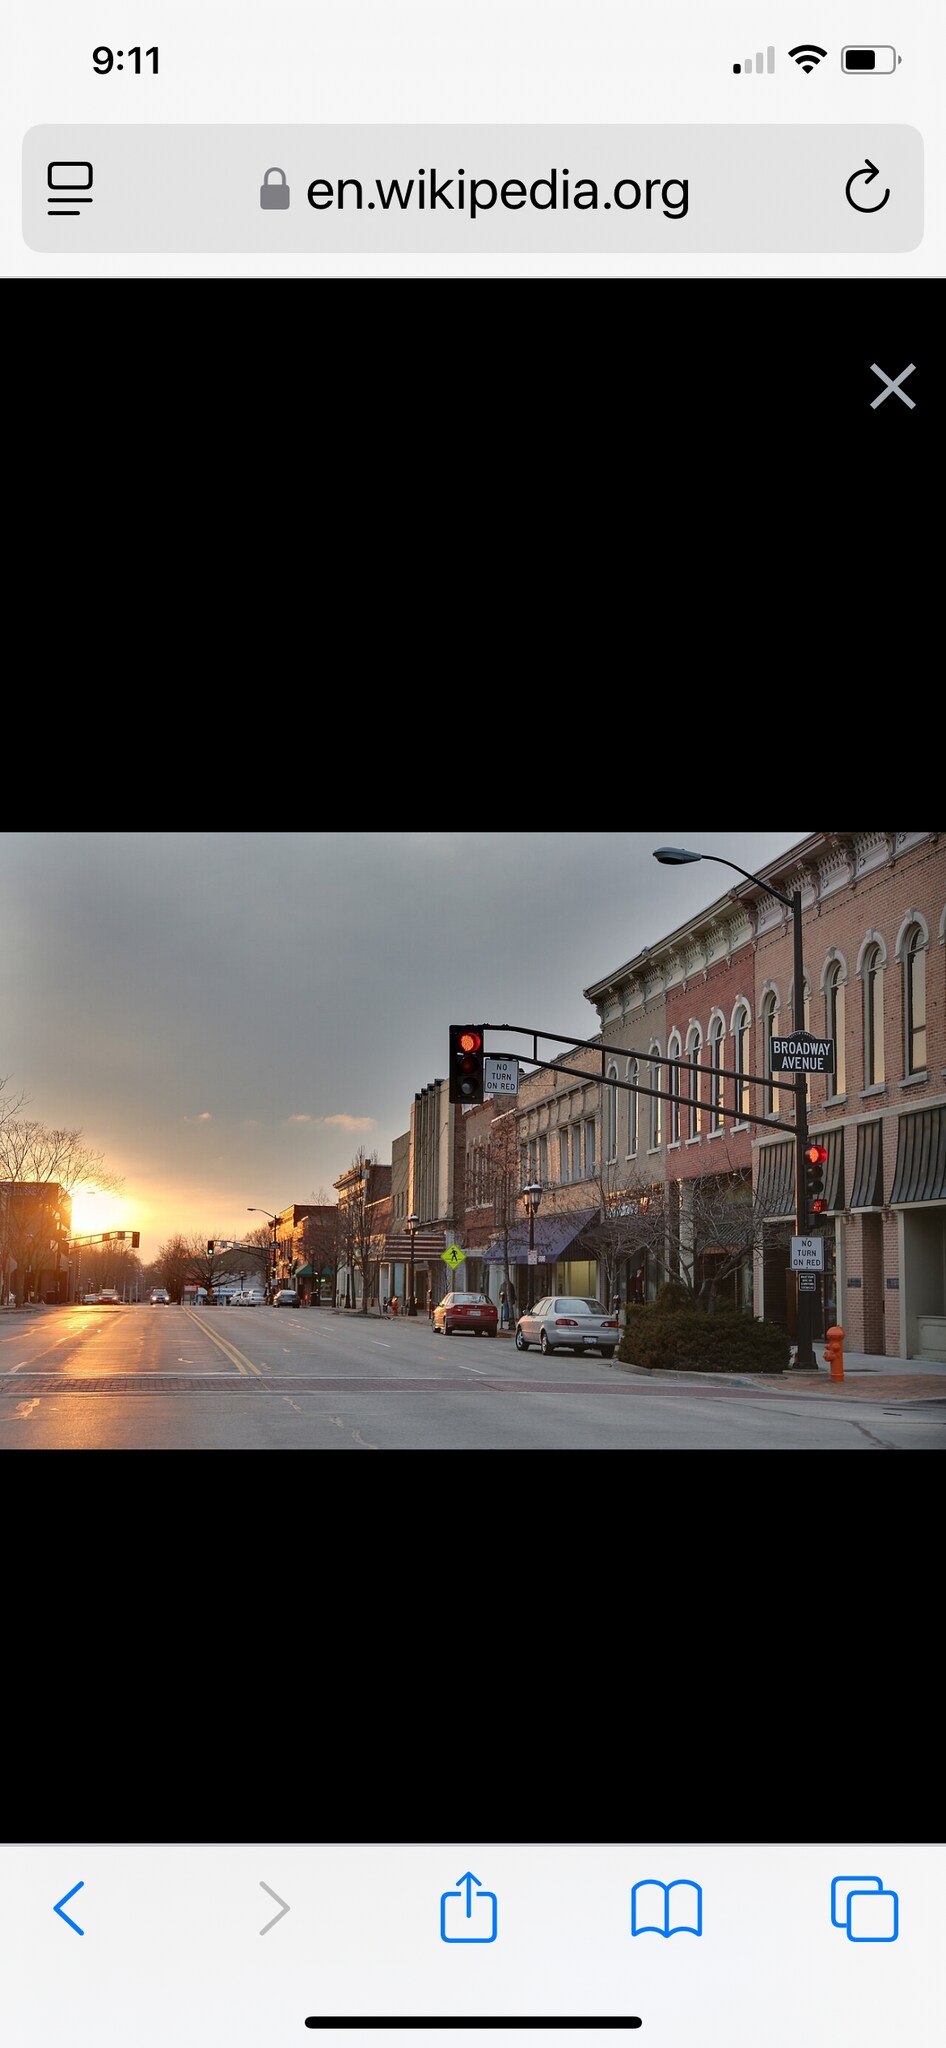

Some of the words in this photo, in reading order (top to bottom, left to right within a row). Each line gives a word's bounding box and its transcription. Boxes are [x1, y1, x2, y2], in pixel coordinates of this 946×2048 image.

[92, 46, 159, 75] 9:11
[307, 168, 689, 220] en.wikipedia.org
[774, 1041, 830, 1056] BROADWAY
[782, 1056, 824, 1070] AVENUE
